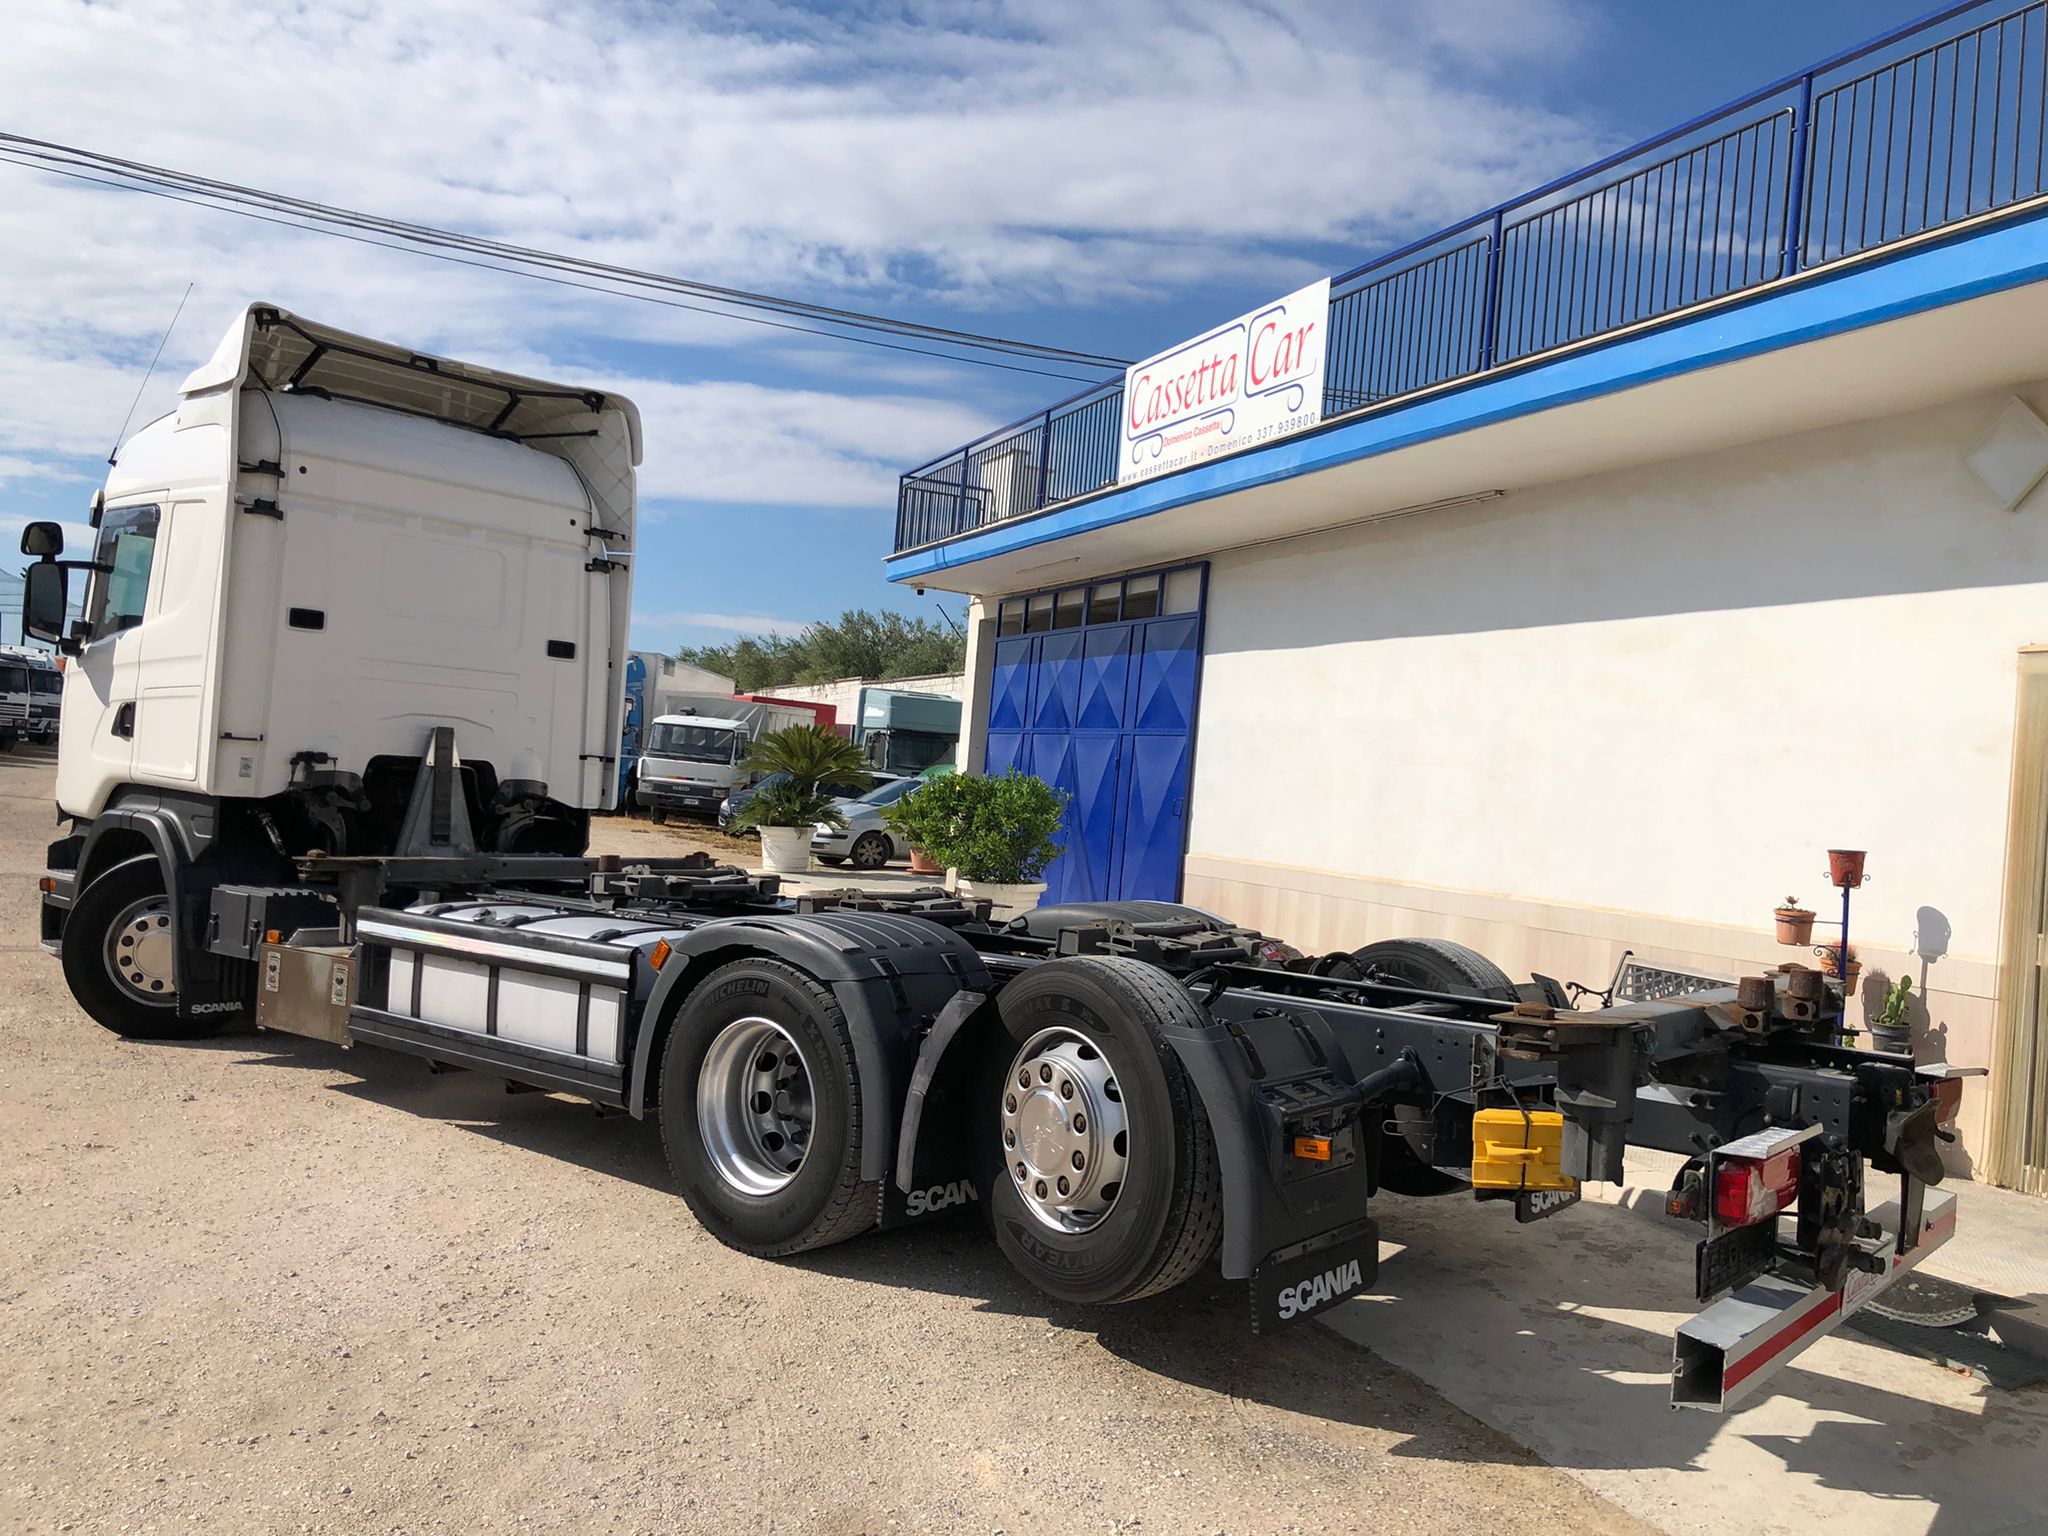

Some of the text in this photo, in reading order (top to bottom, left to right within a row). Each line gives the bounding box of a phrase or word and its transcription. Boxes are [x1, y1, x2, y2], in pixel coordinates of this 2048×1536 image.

[1131, 322, 1315, 430] Cassetta Car
[1163, 430, 1192, 447] Domenico
[1207, 434, 1253, 456] Domenico
[191, 1001, 243, 1014] SCANIA
[905, 1178, 979, 1216] SCAN
[1278, 1259, 1362, 1319] SCANIA
